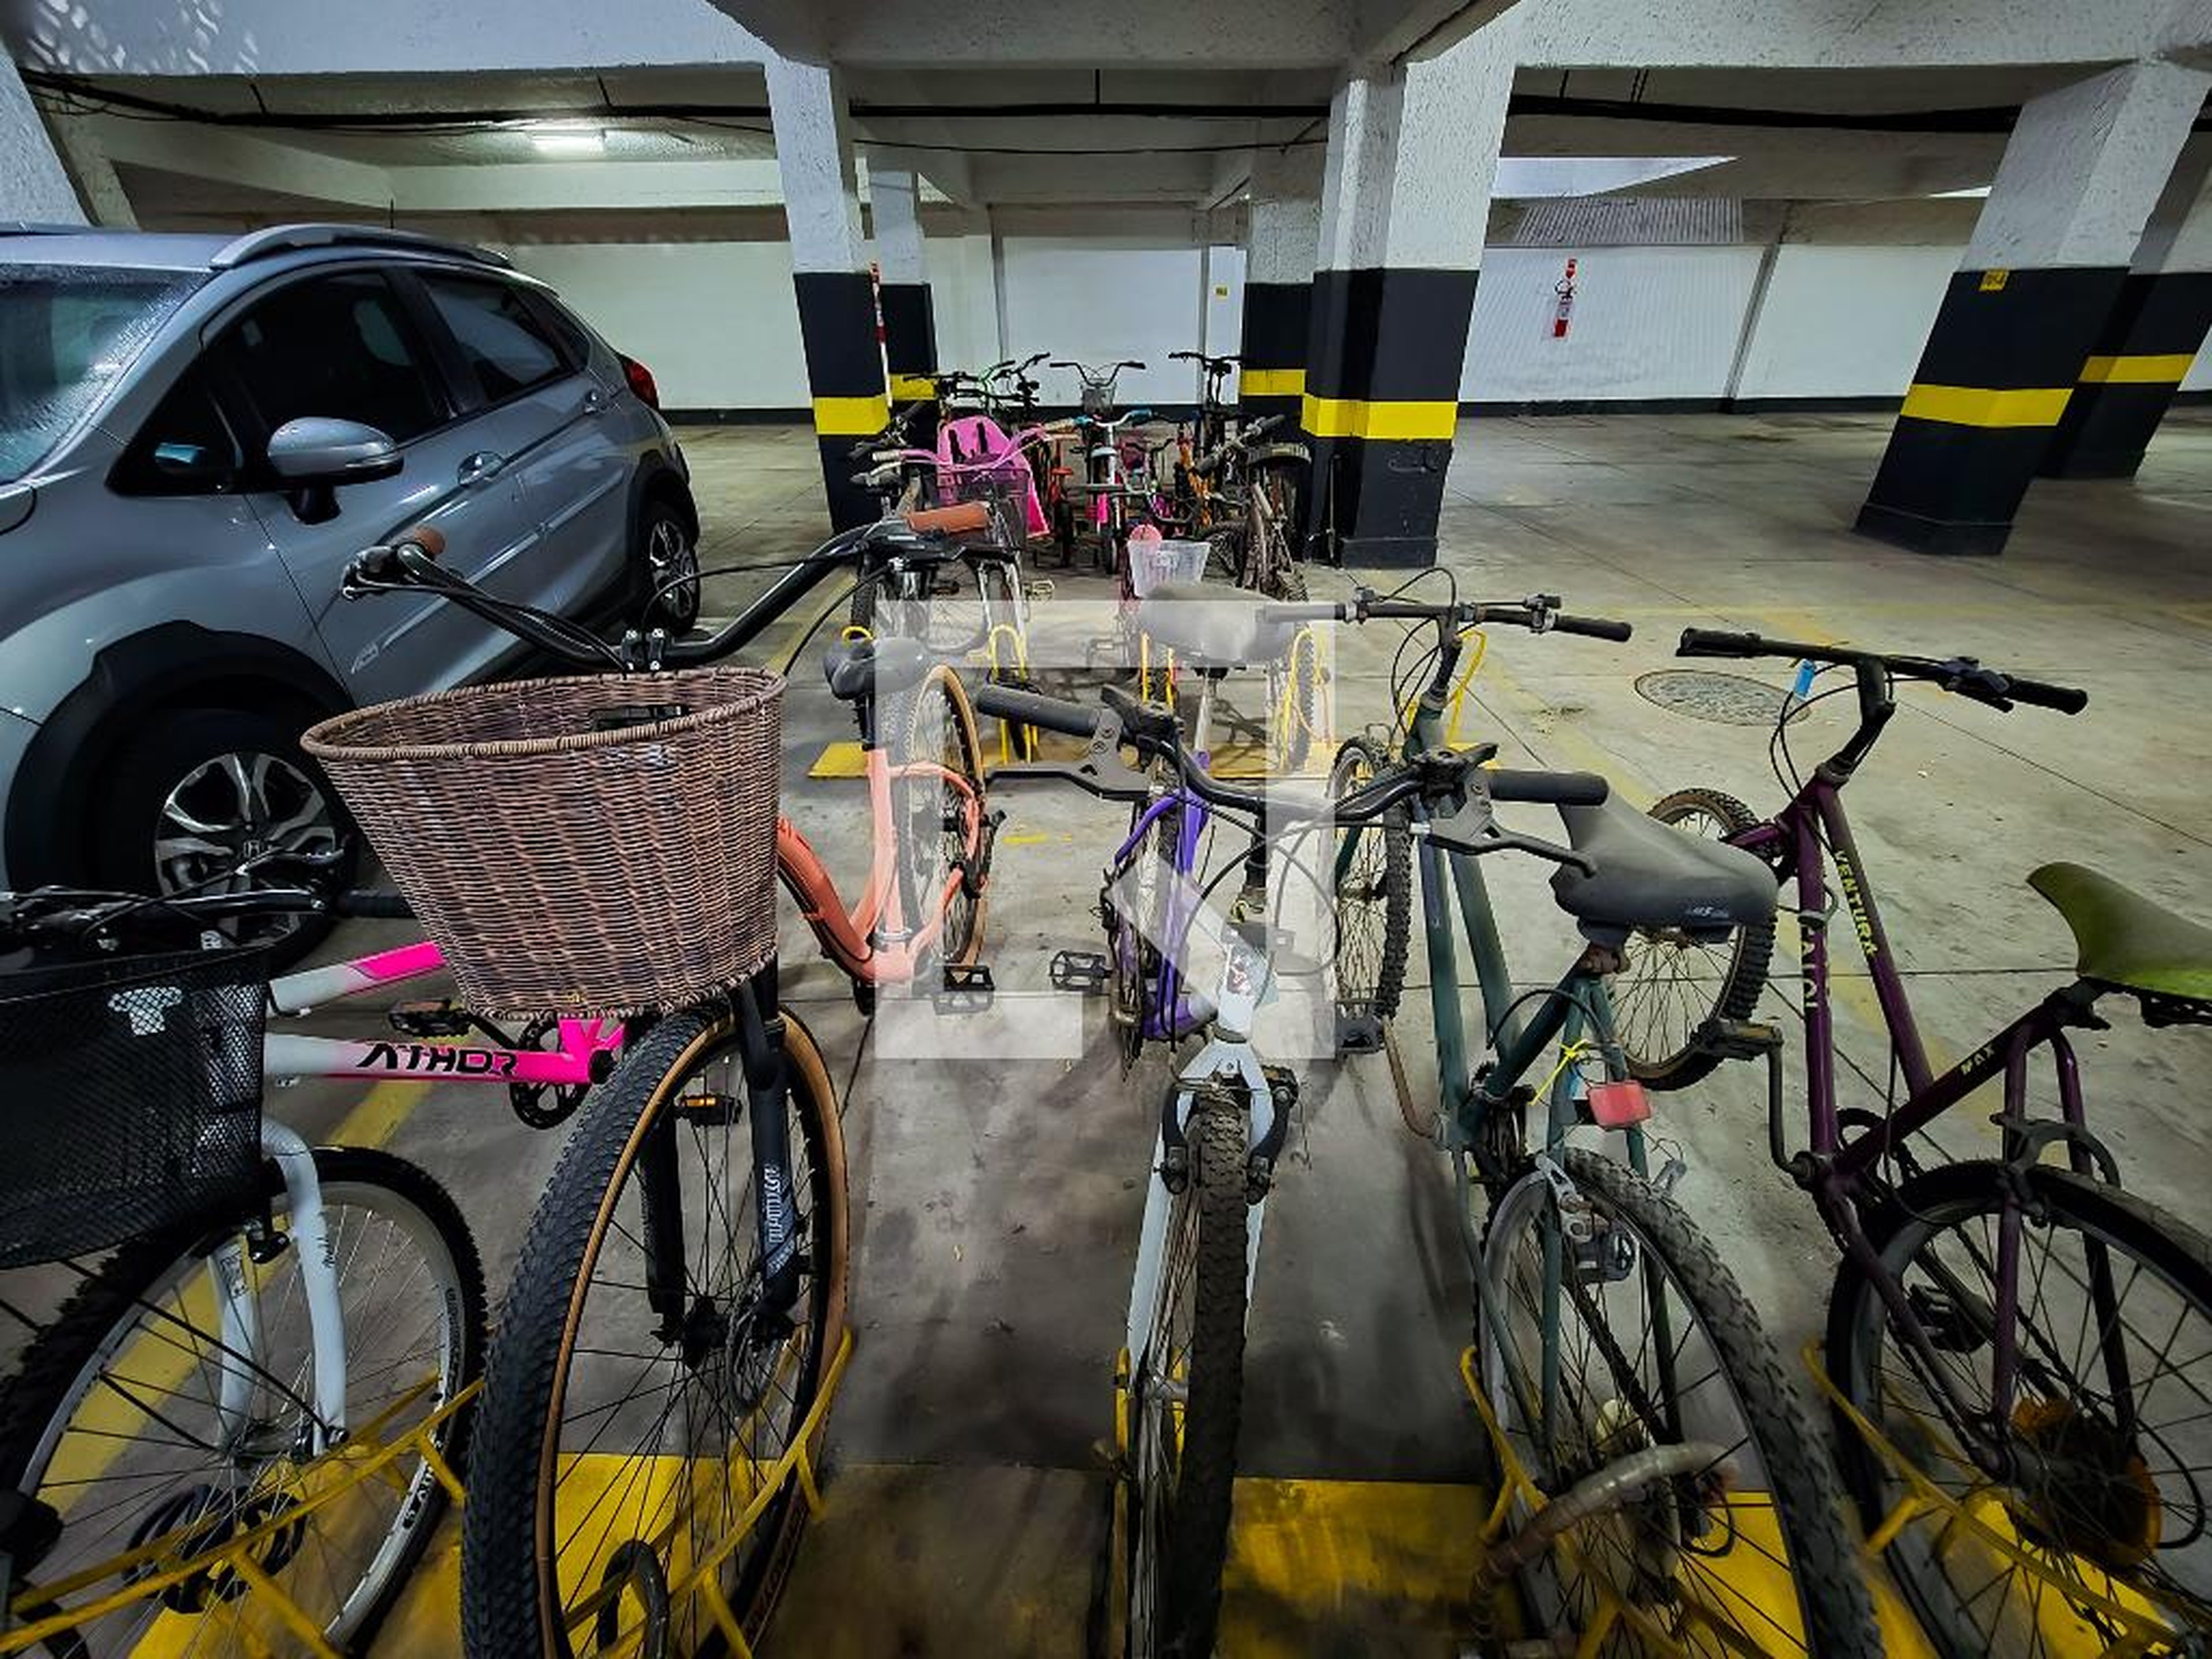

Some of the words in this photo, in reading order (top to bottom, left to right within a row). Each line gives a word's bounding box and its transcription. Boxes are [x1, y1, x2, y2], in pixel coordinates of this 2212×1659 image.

[1835, 850, 1877, 957] VENTURA
[356, 1043, 517, 1076] ATHOR
[1961, 1043, 1994, 1076] MAX
